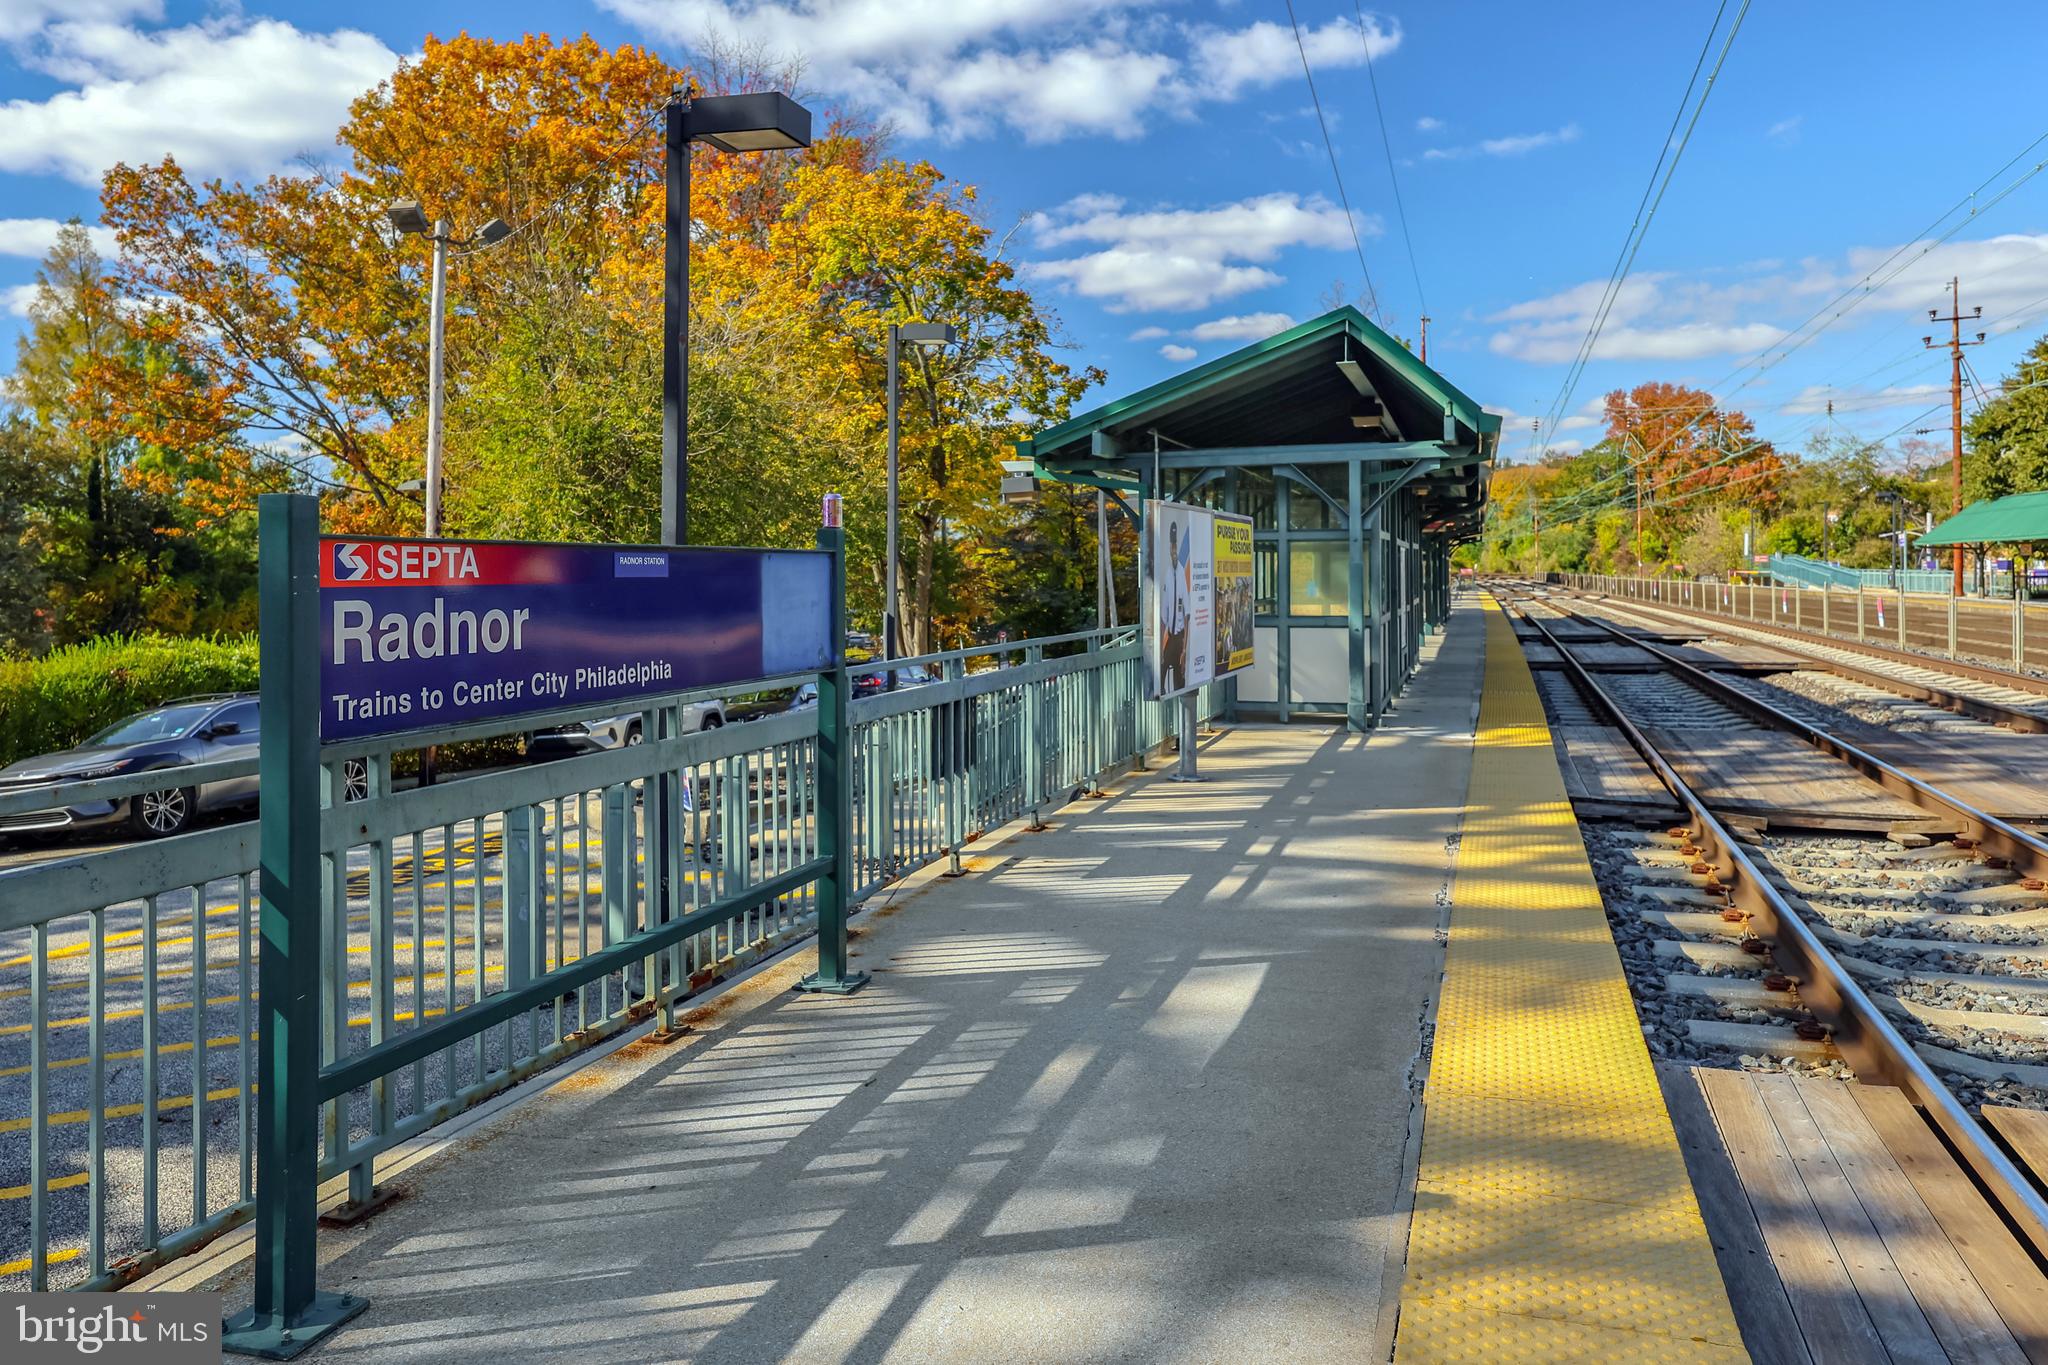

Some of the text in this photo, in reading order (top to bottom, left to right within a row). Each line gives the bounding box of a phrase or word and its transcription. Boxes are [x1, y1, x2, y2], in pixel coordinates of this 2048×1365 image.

[1235, 527, 1249, 541] YOUR
[377, 545, 480, 580] SEPTA
[619, 556, 665, 565] RADNOR STATION
[333, 597, 530, 665] Radnor
[332, 659, 672, 721] Trains to Center City Philadelphia
